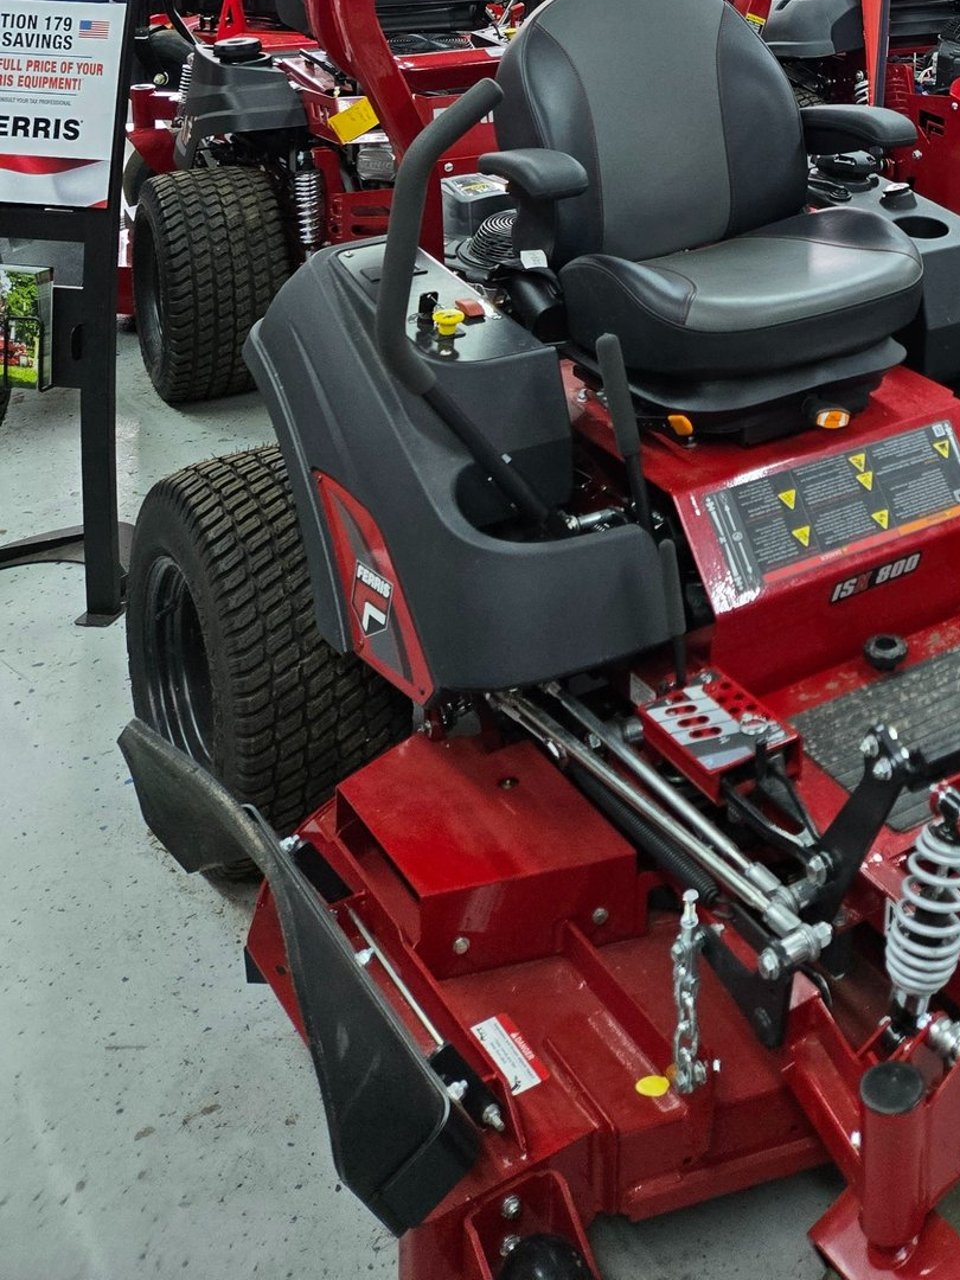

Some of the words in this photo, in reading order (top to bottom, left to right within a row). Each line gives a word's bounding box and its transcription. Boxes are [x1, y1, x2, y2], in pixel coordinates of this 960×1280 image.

[1, 13, 38, 29] TION
[45, 15, 73, 31] 179
[2, 31, 73, 50] SAVINGS
[26, 59, 57, 73] PRICE
[60, 61, 73, 74] OF
[76, 62, 104, 76] YOUR
[17, 75, 81, 90] EQUIPMENT!
[875, 553, 921, 584] 800
[357, 564, 391, 599] FERRIS
